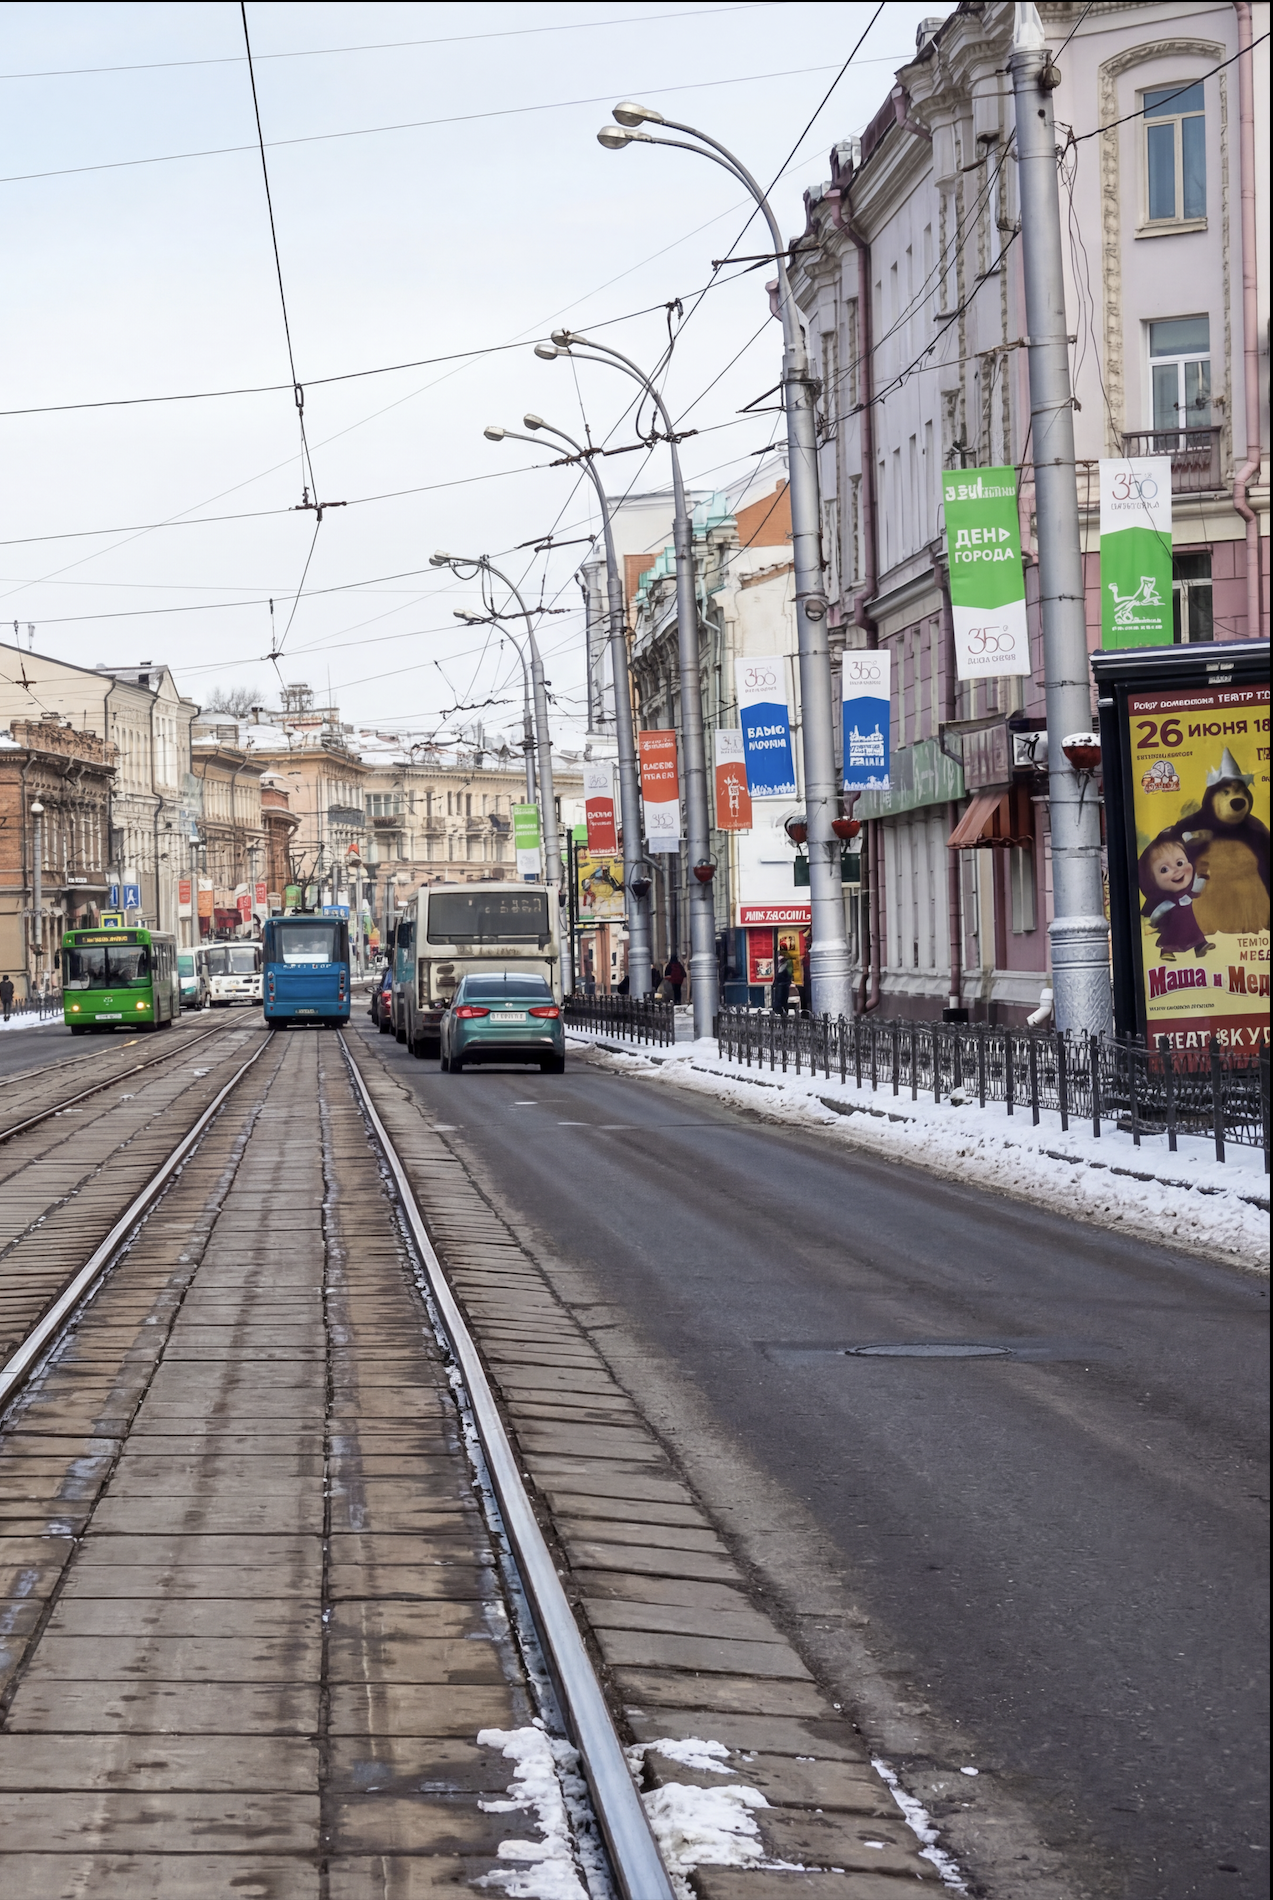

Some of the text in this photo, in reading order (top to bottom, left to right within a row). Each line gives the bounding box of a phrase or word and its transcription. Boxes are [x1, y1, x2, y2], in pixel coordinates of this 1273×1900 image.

[954, 547, 1015, 564] ГОРОДА
[1136, 718, 1184, 749] 26
[1188, 720, 1248, 738] ИЮНЯ
[1148, 966, 1208, 999] Маша
